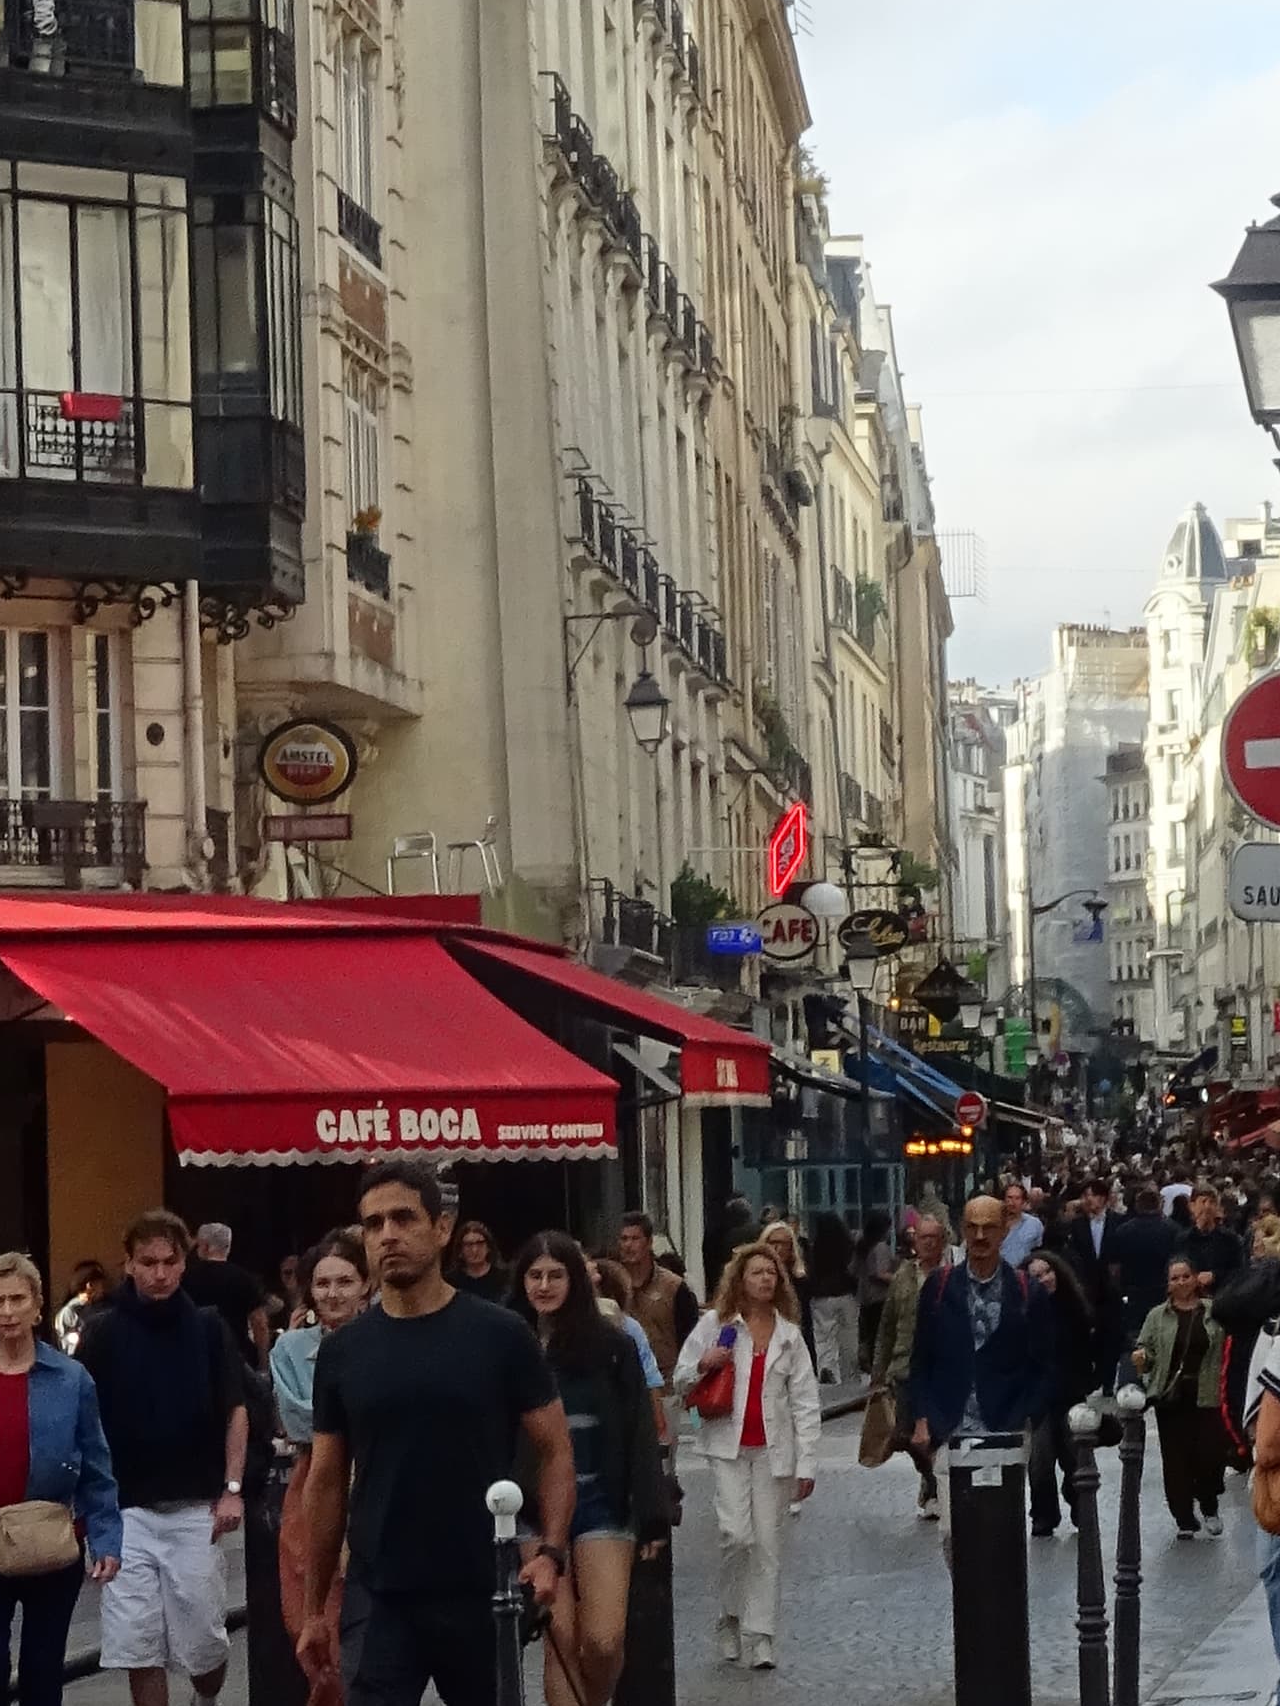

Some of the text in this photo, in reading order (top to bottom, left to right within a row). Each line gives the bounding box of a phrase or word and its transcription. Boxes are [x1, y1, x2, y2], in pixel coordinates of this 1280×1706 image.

[281, 749, 330, 764] AMSTEL
[315, 1099, 392, 1144] CAFÉ
[398, 1107, 482, 1142] BOCA
[497, 1124, 549, 1141] SERVICE
